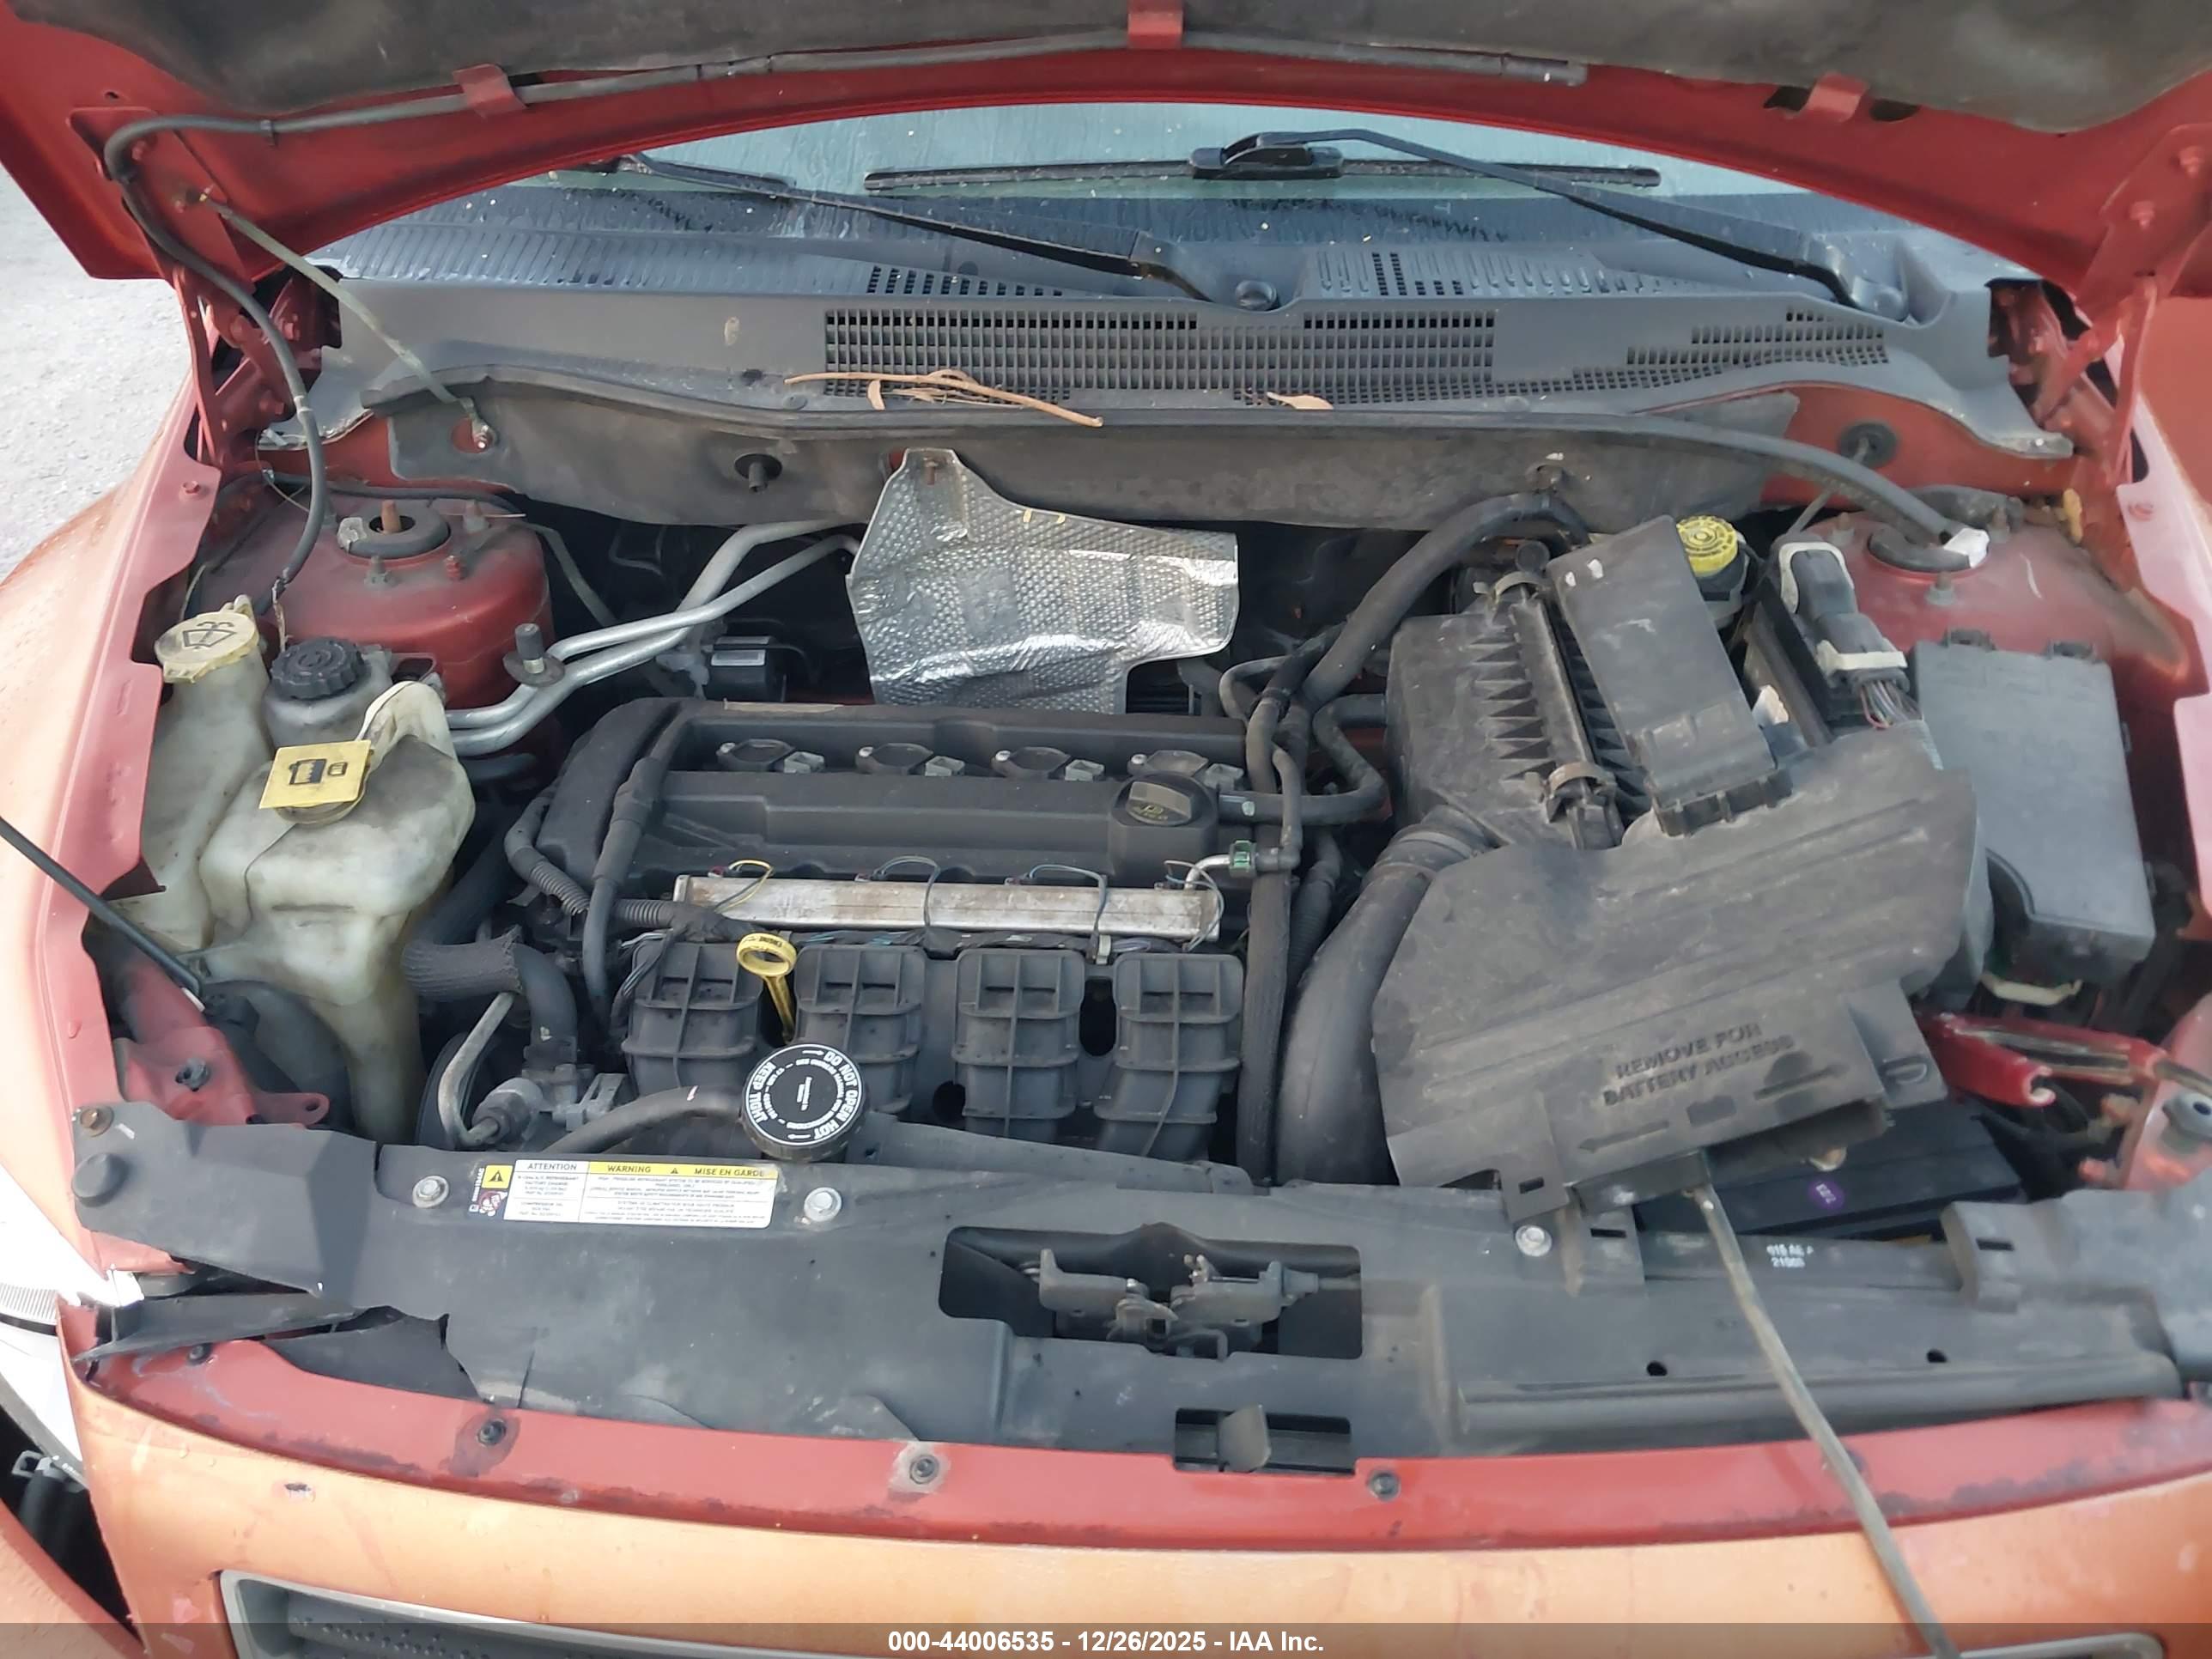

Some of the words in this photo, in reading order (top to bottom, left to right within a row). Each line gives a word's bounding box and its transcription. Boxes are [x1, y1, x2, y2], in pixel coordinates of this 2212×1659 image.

[823, 1050, 843, 1066] DO
[1615, 1036, 1711, 1079] REMOVE
[1715, 1023, 1762, 1048] FOR
[752, 1061, 776, 1091] KEEP
[838, 1064, 858, 1087] NOT
[1602, 1063, 1697, 1106] BATTERY
[1705, 1034, 1795, 1076] ACCESS
[749, 1091, 769, 1123] TIGHT
[836, 1089, 858, 1122] OPEN
[813, 1120, 840, 1139] HOT
[607, 1164, 652, 1173] WARNING
